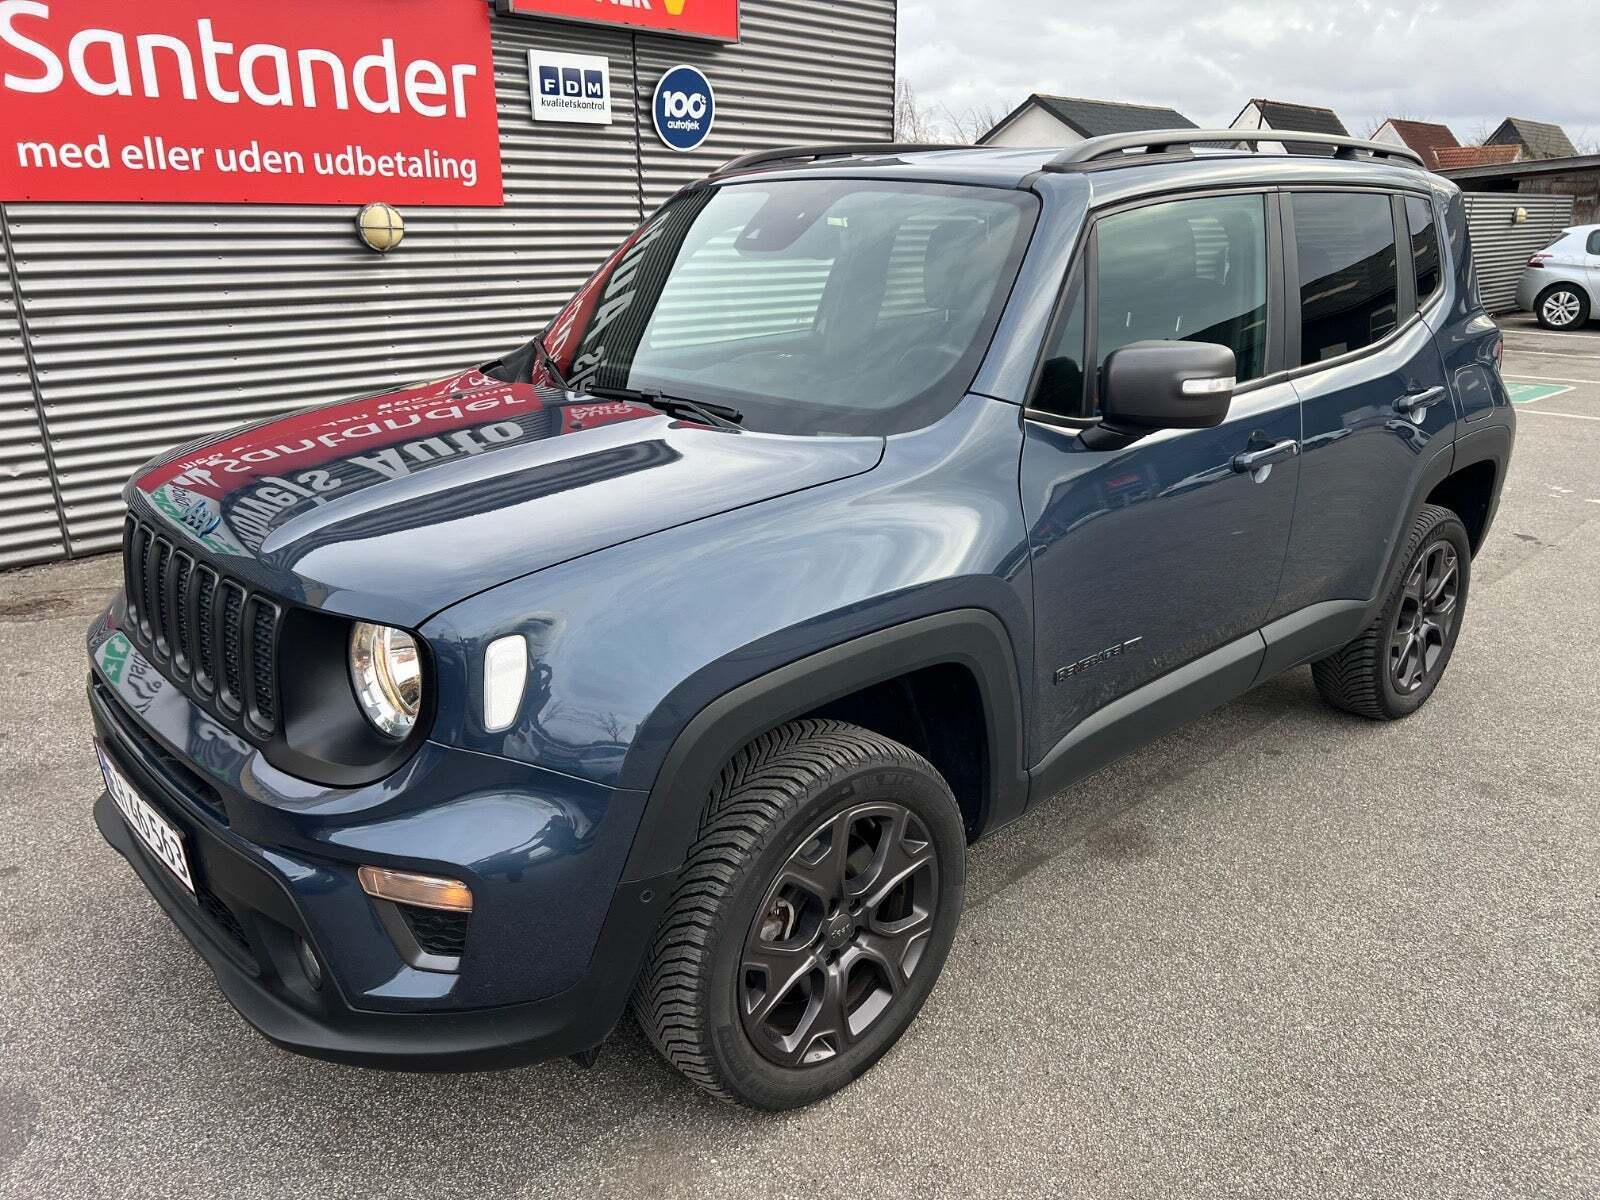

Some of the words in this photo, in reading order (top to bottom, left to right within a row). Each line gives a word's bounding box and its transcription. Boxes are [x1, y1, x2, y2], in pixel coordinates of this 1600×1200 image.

[0, 0, 476, 118] Santander
[543, 78, 601, 96] FDM
[541, 98, 605, 111] kvalitetskontrol
[667, 120, 700, 131] autotjek
[17, 135, 110, 169] med
[121, 137, 204, 172] eller
[215, 142, 304, 174] uden
[314, 147, 477, 187] udbetaling
